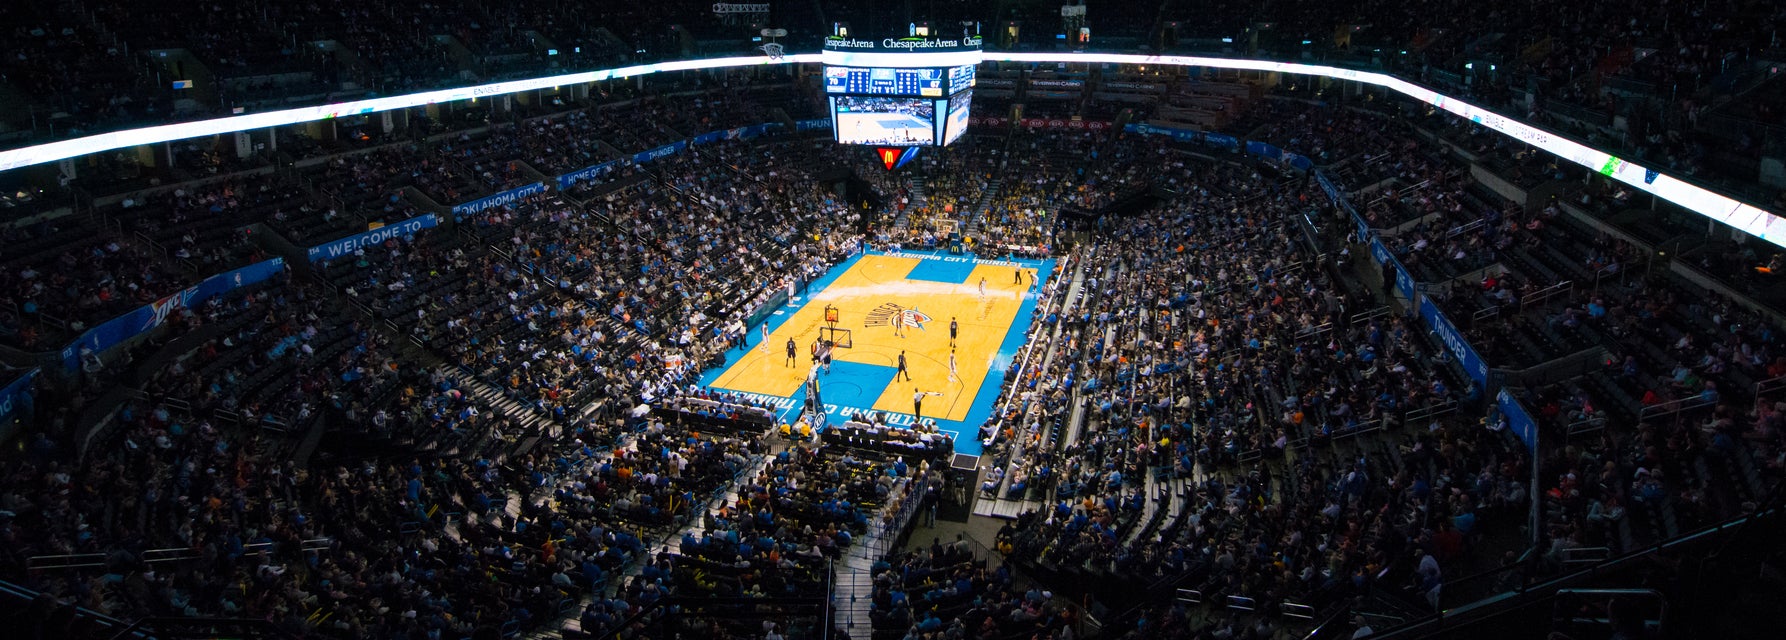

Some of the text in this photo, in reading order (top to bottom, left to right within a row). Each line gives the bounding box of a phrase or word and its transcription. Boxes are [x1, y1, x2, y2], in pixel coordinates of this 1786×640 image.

[825, 37, 874, 50] Chesapeake Arena
[883, 38, 958, 51] Chesapeake Arena
[649, 146, 674, 160] THUNDER
[568, 171, 589, 184] HOME
[461, 193, 515, 214] OKLAHOMA
[518, 186, 538, 198] CITY
[328, 227, 400, 257] WELCOME
[404, 220, 421, 232] TO
[1434, 315, 1466, 364] THUNDER
